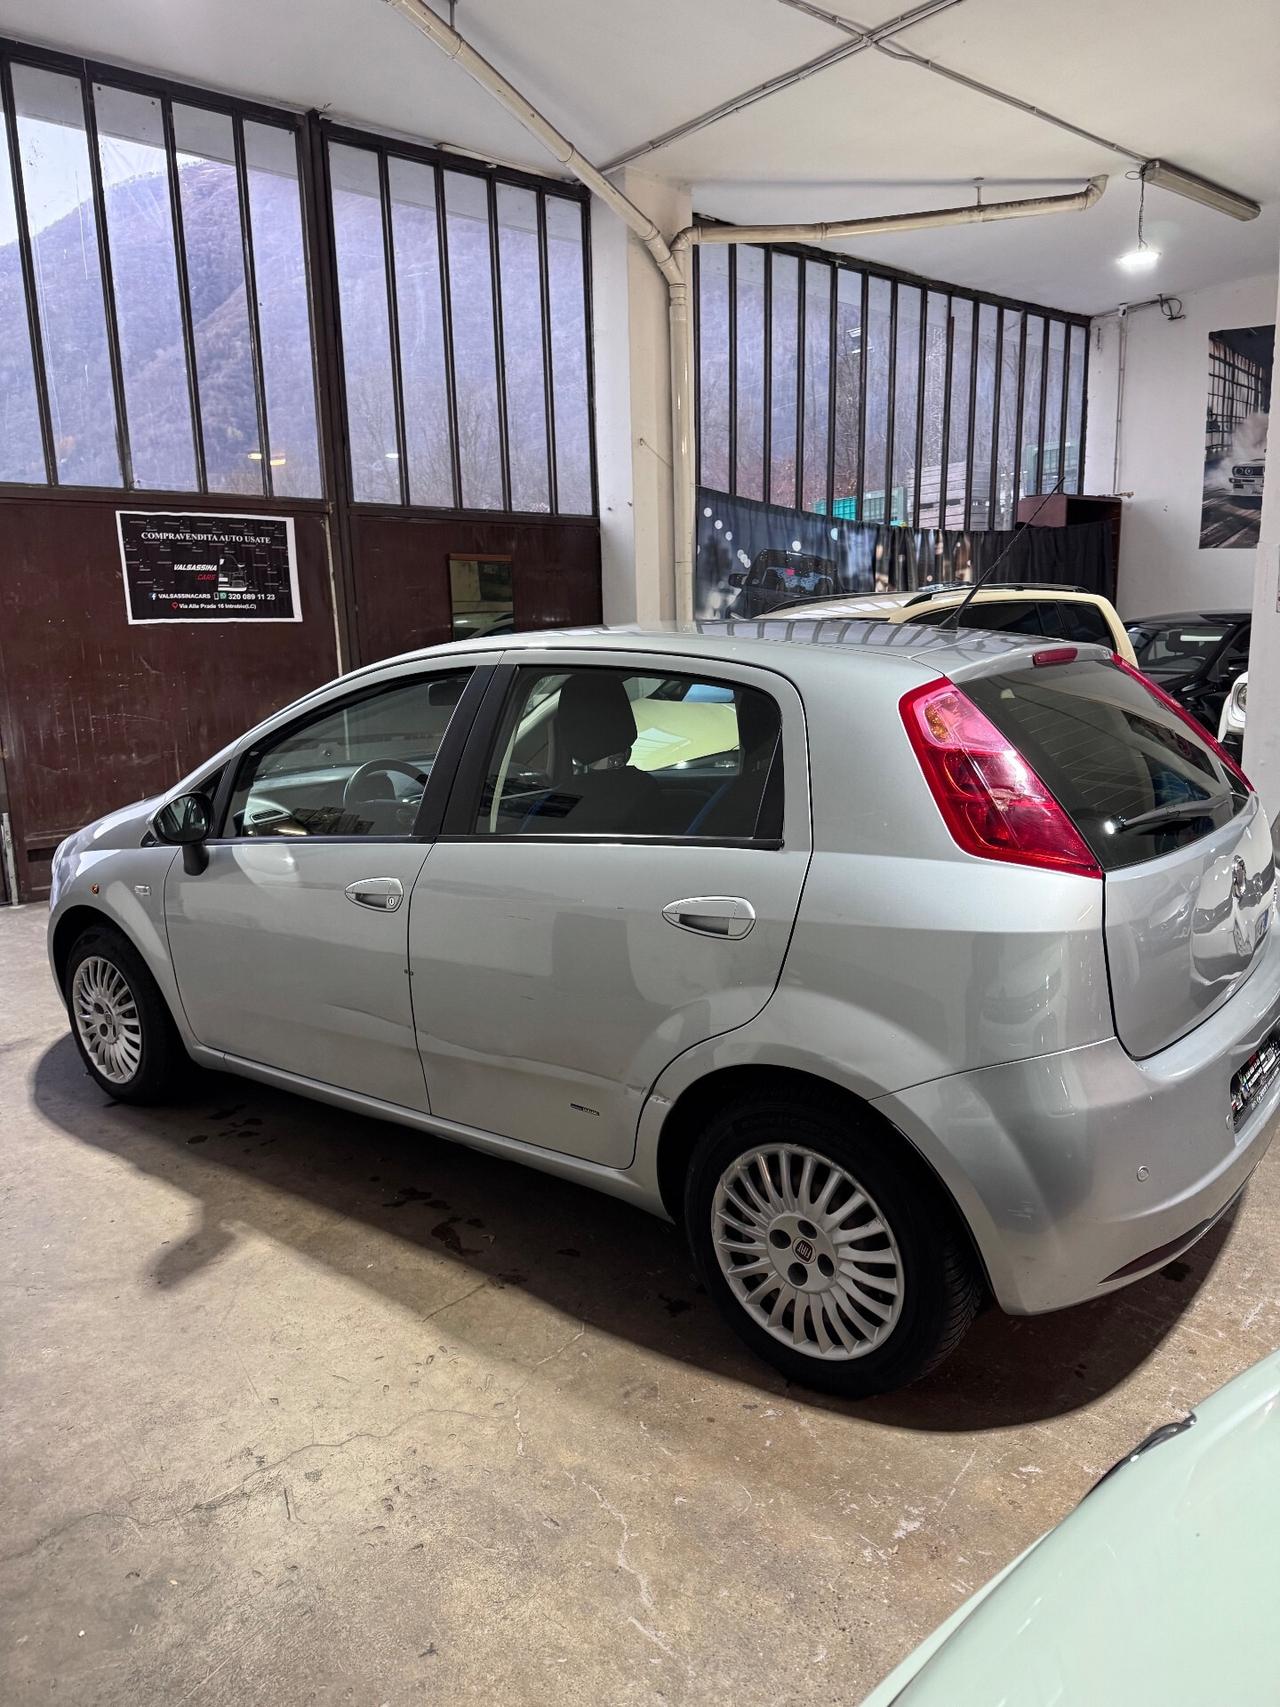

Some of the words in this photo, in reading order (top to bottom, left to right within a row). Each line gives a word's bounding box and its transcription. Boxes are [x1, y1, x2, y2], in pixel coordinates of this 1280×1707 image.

[141, 532, 218, 541] COMPRAVENDITA
[219, 534, 243, 543] AUTO
[245, 536, 271, 544] USATE
[174, 563, 217, 571] VALSASSINA
